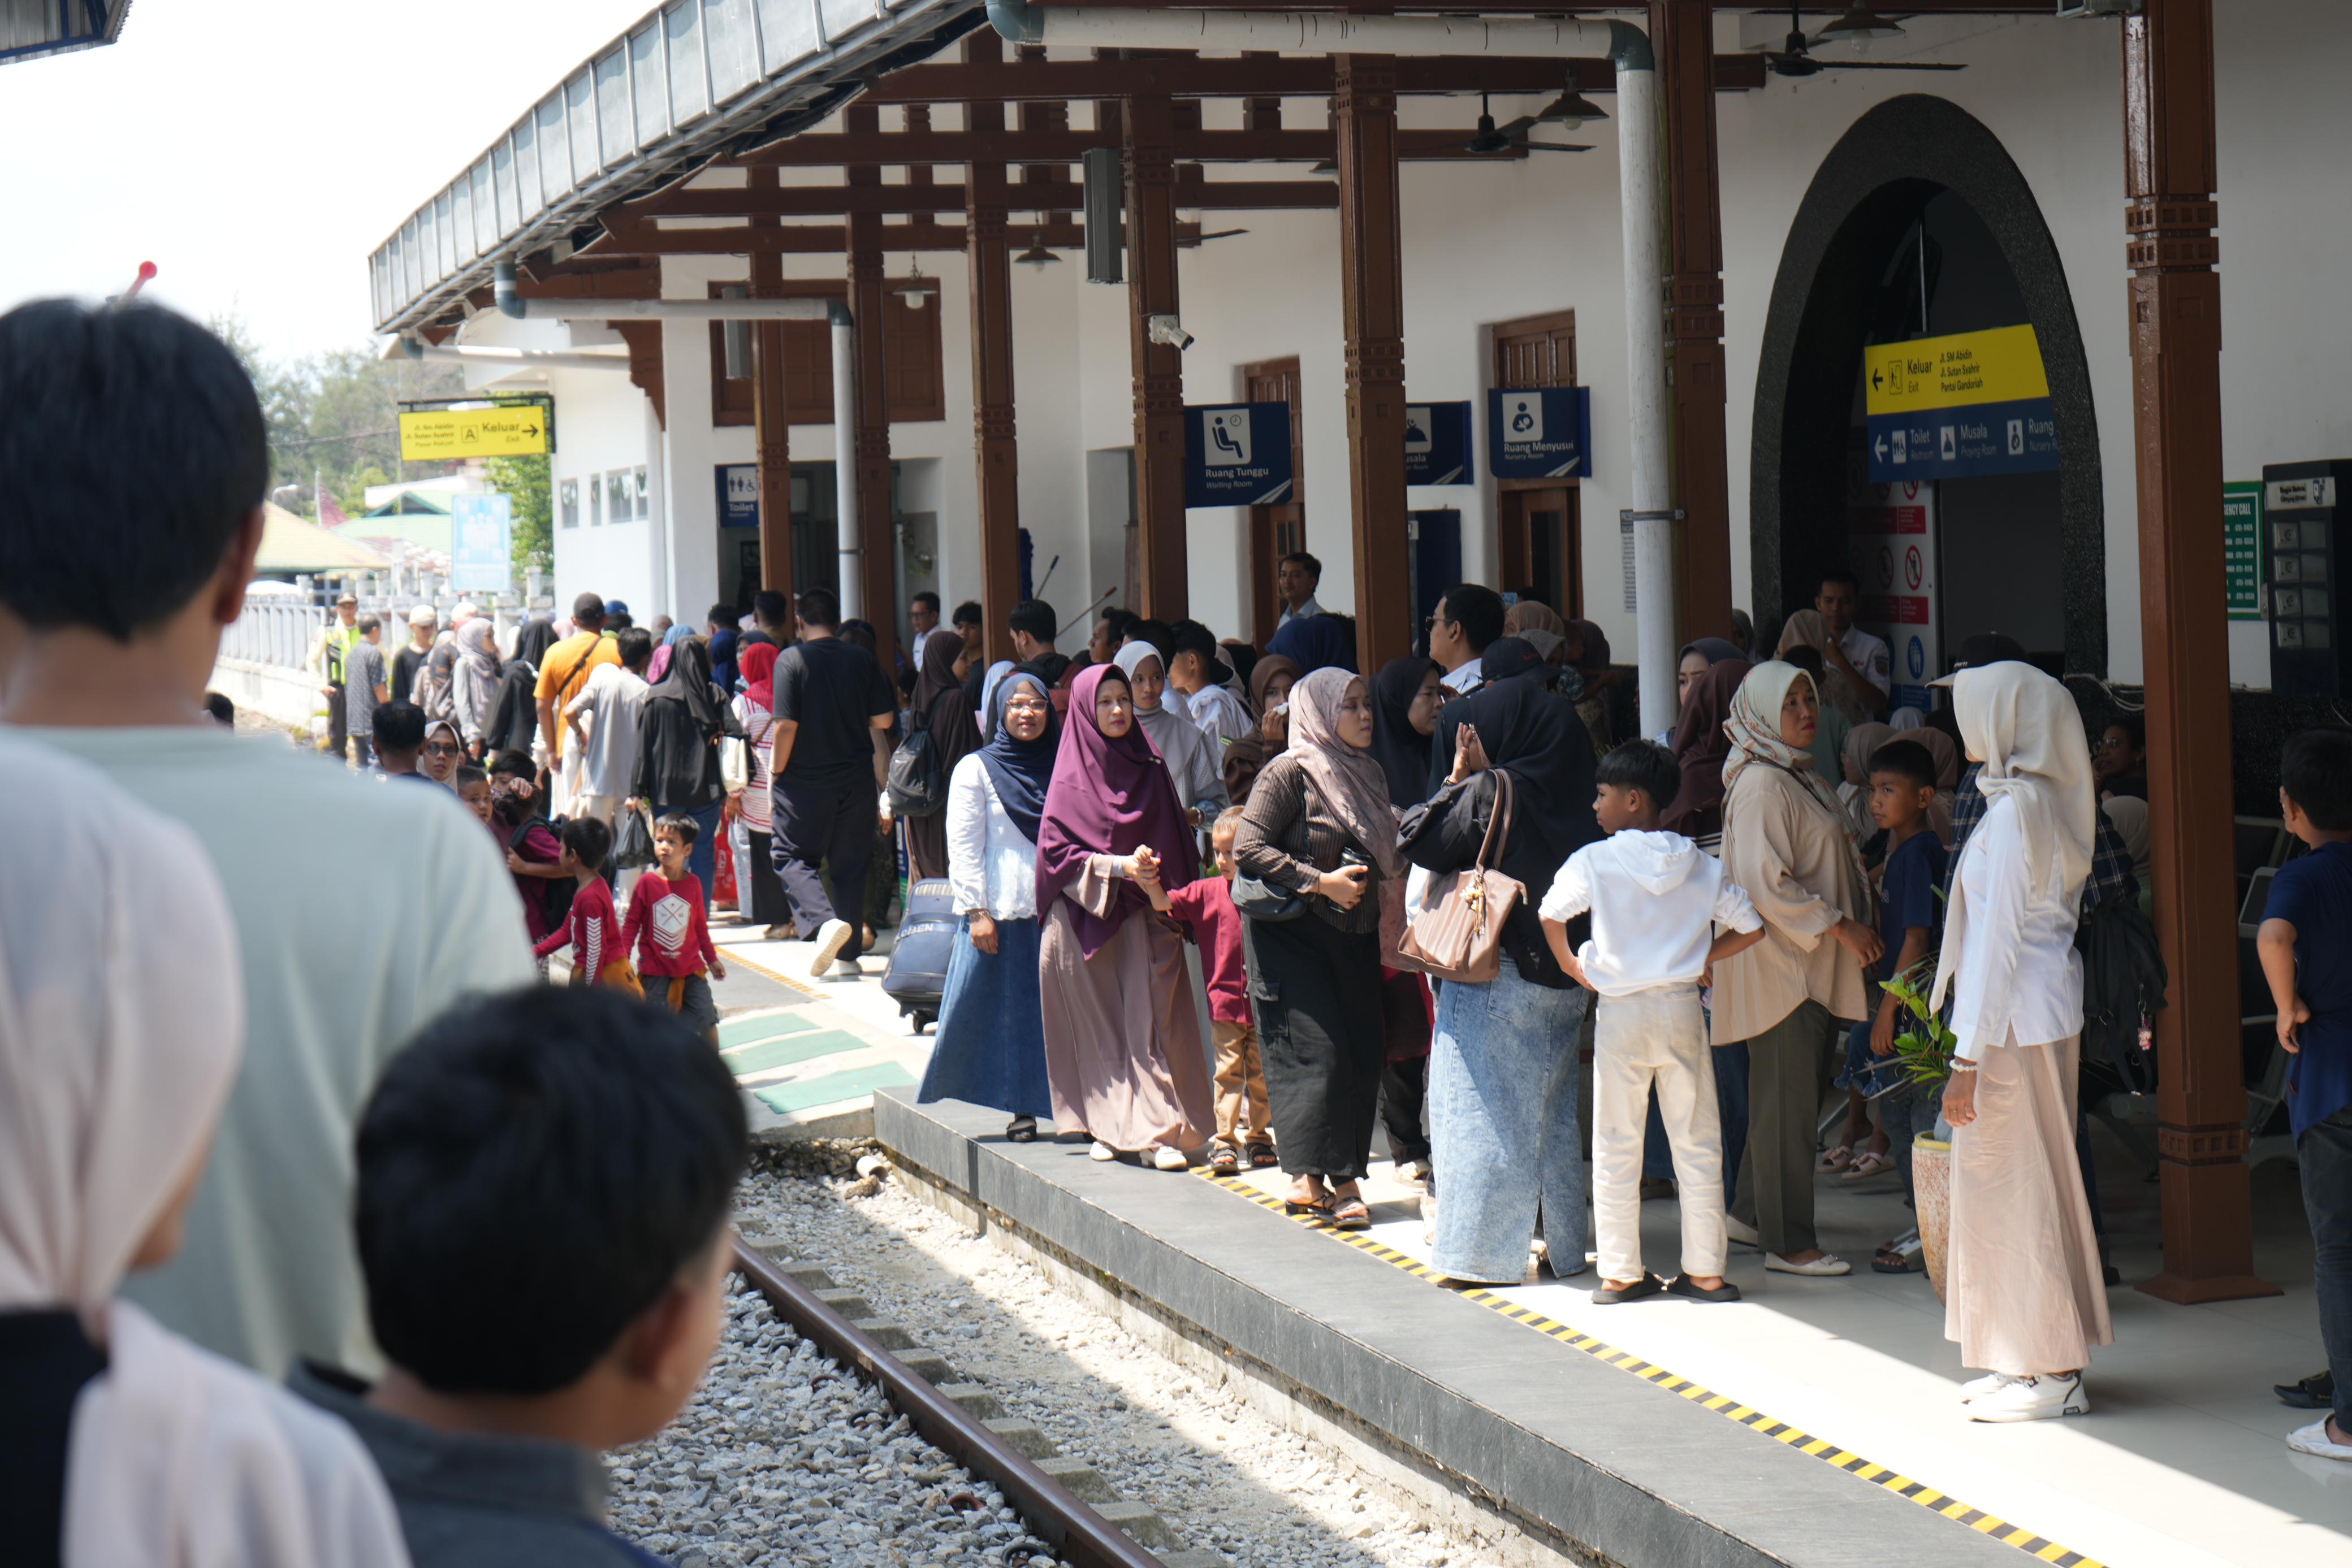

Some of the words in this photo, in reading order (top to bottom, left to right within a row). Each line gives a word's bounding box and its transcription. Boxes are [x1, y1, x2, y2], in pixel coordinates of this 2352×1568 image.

[1947, 350, 1955, 362] SM
[1956, 348, 1972, 360] Abidin
[1908, 358, 1932, 375] Keluar
[1947, 366, 1961, 377] Sutan
[1962, 362, 1980, 376] Syahrir
[1908, 379, 1918, 393] Exit
[1941, 380, 1956, 392] Pantai
[1957, 377, 1983, 391] Gandoriah
[465, 428, 475, 439] A
[482, 422, 520, 432] Keluar
[1910, 428, 1930, 444] Toilet
[1960, 423, 1987, 439] Musala
[2028, 418, 2053, 436] Ruang
[506, 435, 520, 443] Exit
[1503, 441, 1530, 454] Ruang
[1532, 440, 1574, 453] Menyusui
[1981, 443, 1996, 456] Room
[1205, 469, 1234, 479] Ruang
[1235, 467, 1268, 477] Tunggu
[729, 503, 755, 512] Toilet
[2238, 503, 2251, 516] CALL
